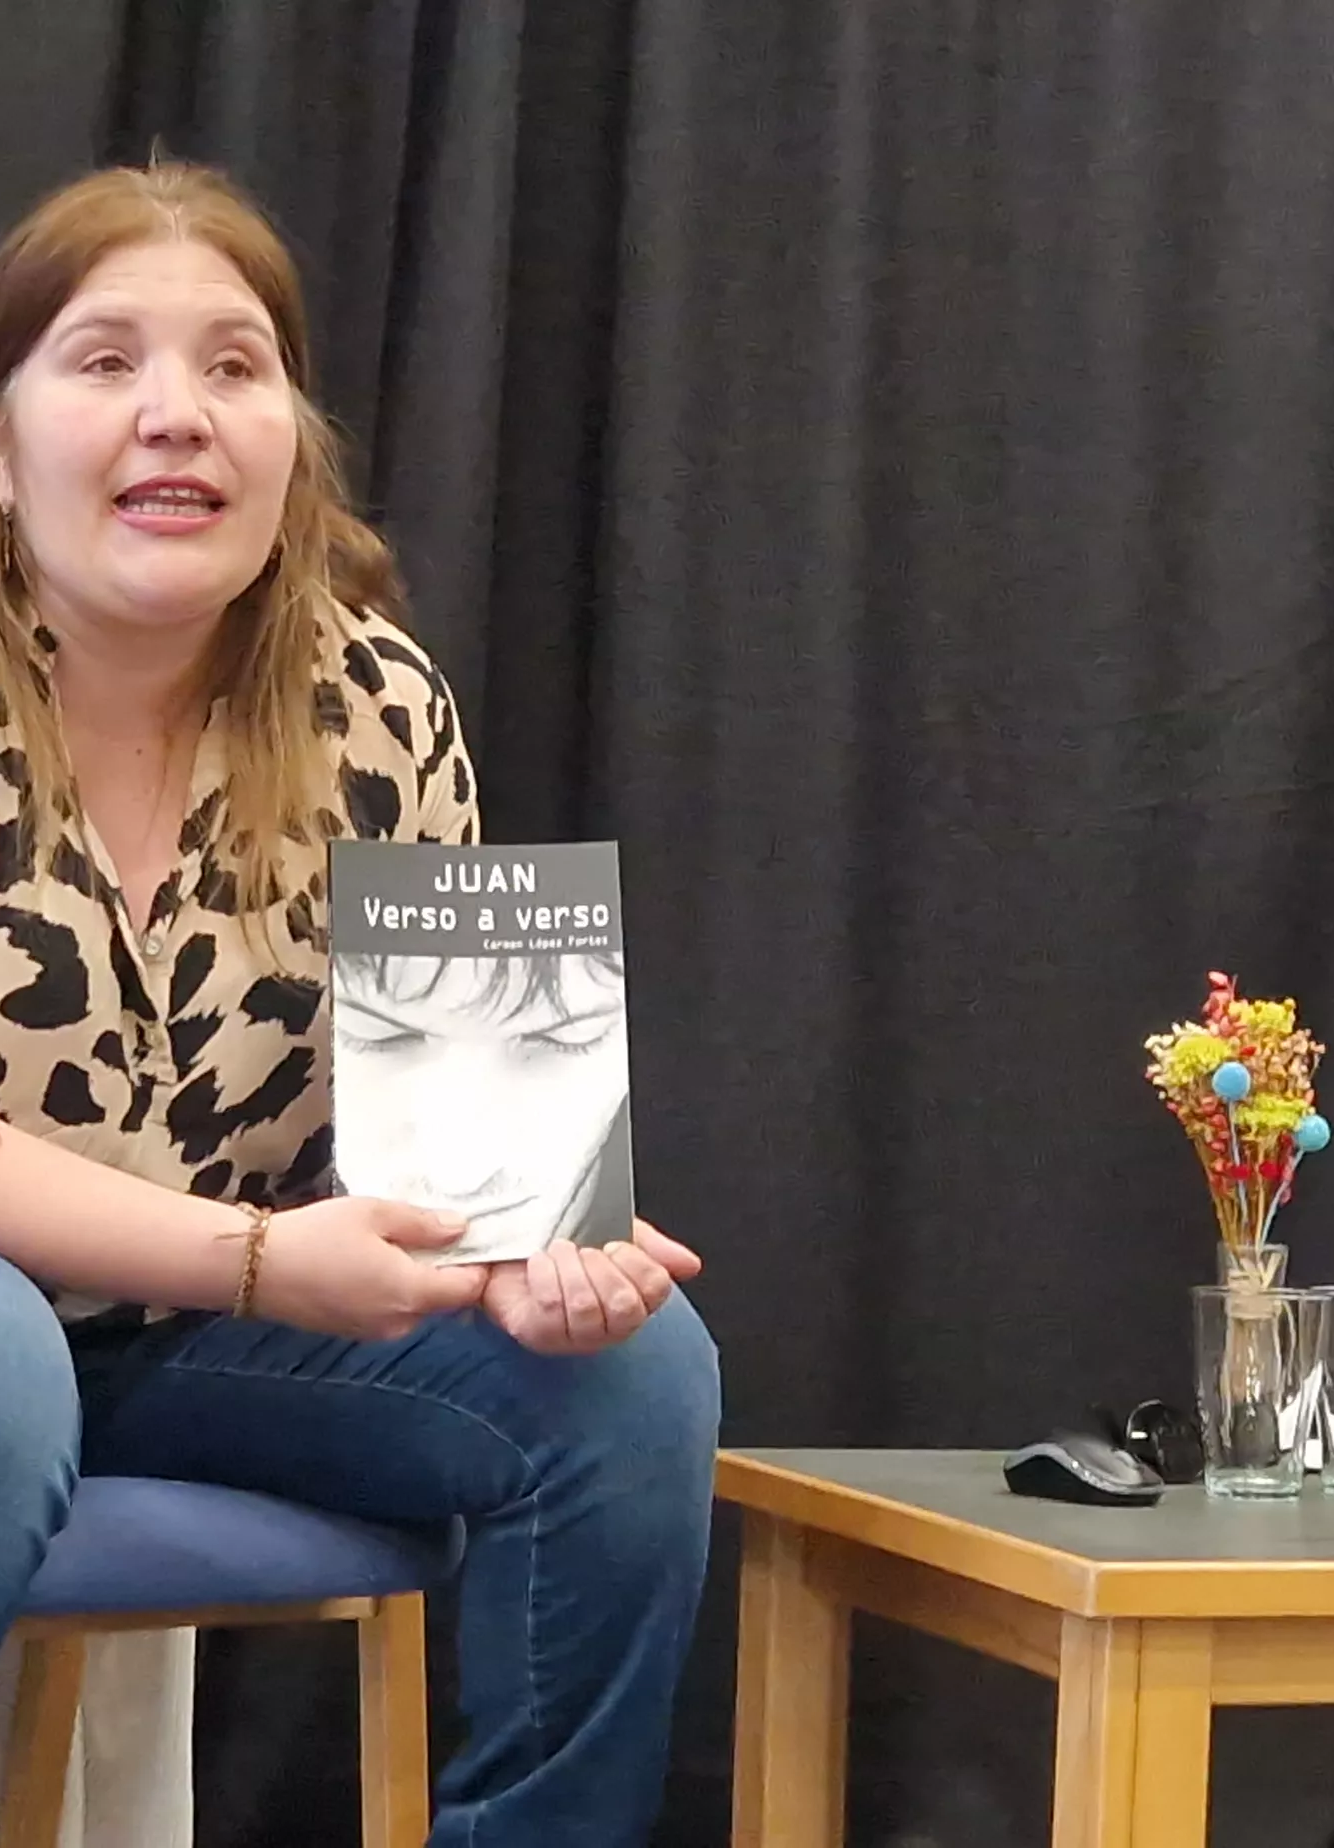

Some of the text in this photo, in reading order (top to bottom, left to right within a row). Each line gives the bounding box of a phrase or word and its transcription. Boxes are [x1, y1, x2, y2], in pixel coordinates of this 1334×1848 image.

[434, 863, 536, 893] JUAN
[364, 898, 610, 931] Verso a verso
